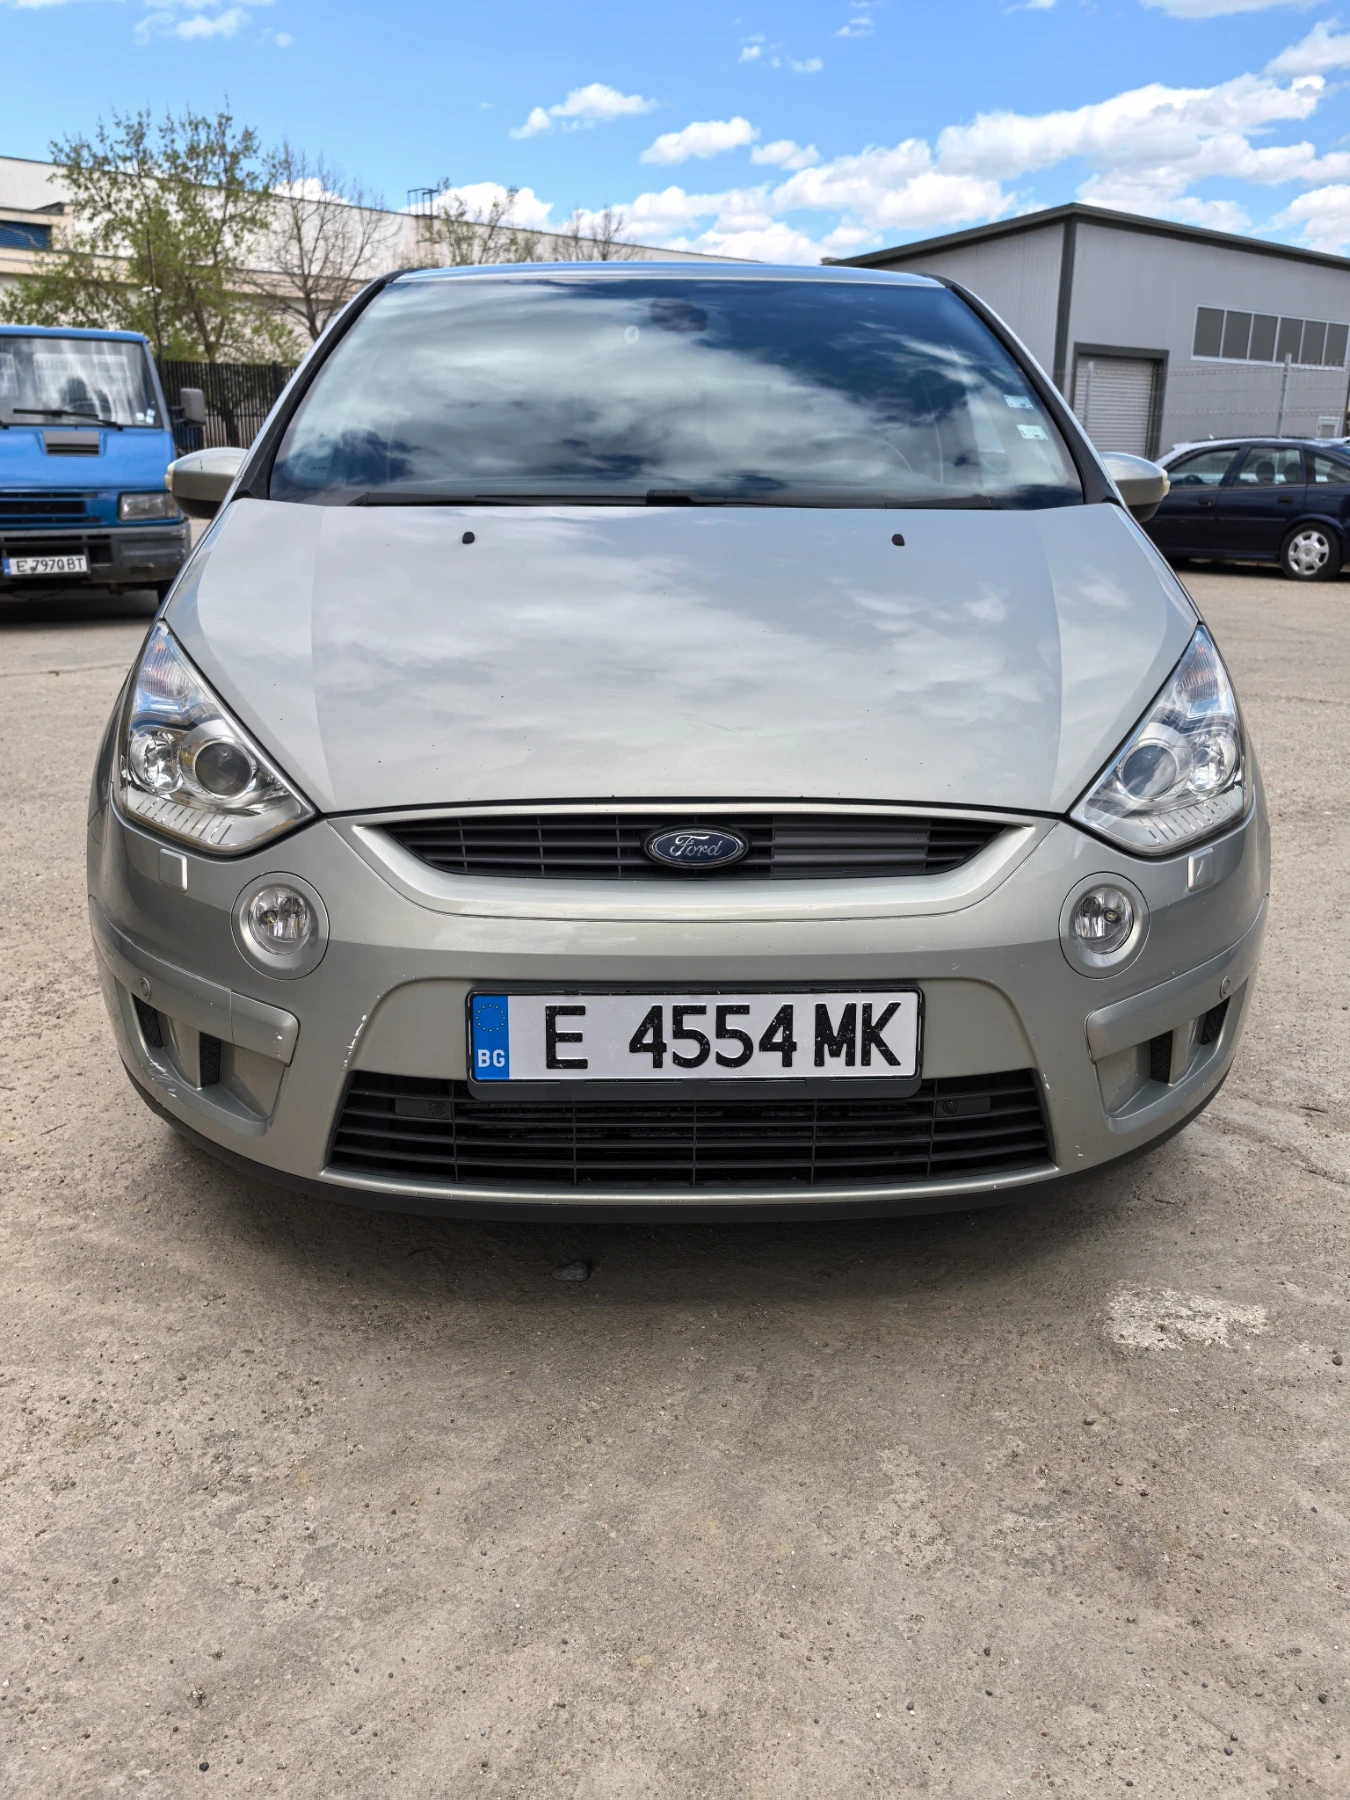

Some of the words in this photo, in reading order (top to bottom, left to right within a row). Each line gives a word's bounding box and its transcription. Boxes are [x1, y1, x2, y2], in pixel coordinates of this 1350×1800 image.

[16, 560, 28, 573] E
[669, 835, 723, 856] Ford
[545, 1005, 588, 1069] E
[629, 1004, 798, 1069] 4554
[814, 1001, 901, 1067] MK
[477, 1049, 505, 1067] BG
